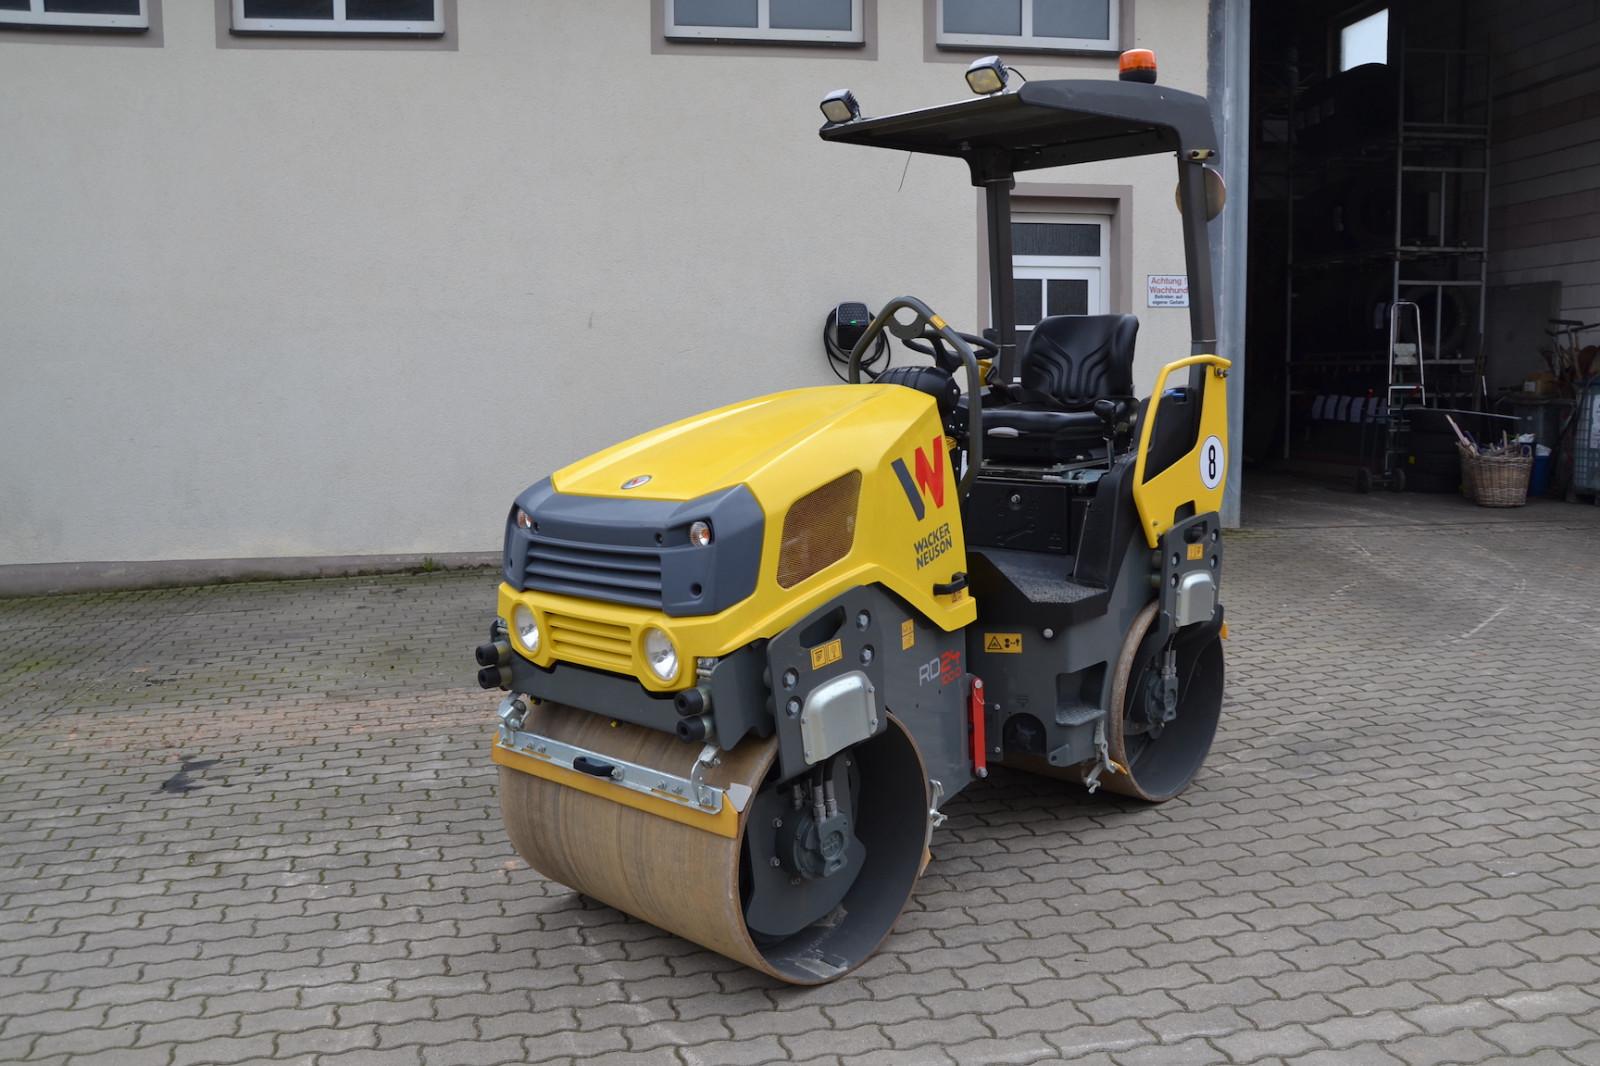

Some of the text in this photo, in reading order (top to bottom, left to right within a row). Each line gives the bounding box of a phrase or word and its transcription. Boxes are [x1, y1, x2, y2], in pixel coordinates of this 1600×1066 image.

[1151, 277, 1182, 286] Achtung
[1208, 444, 1216, 480] 8
[913, 522, 951, 554] WACKER
[915, 536, 953, 570] NEUSON
